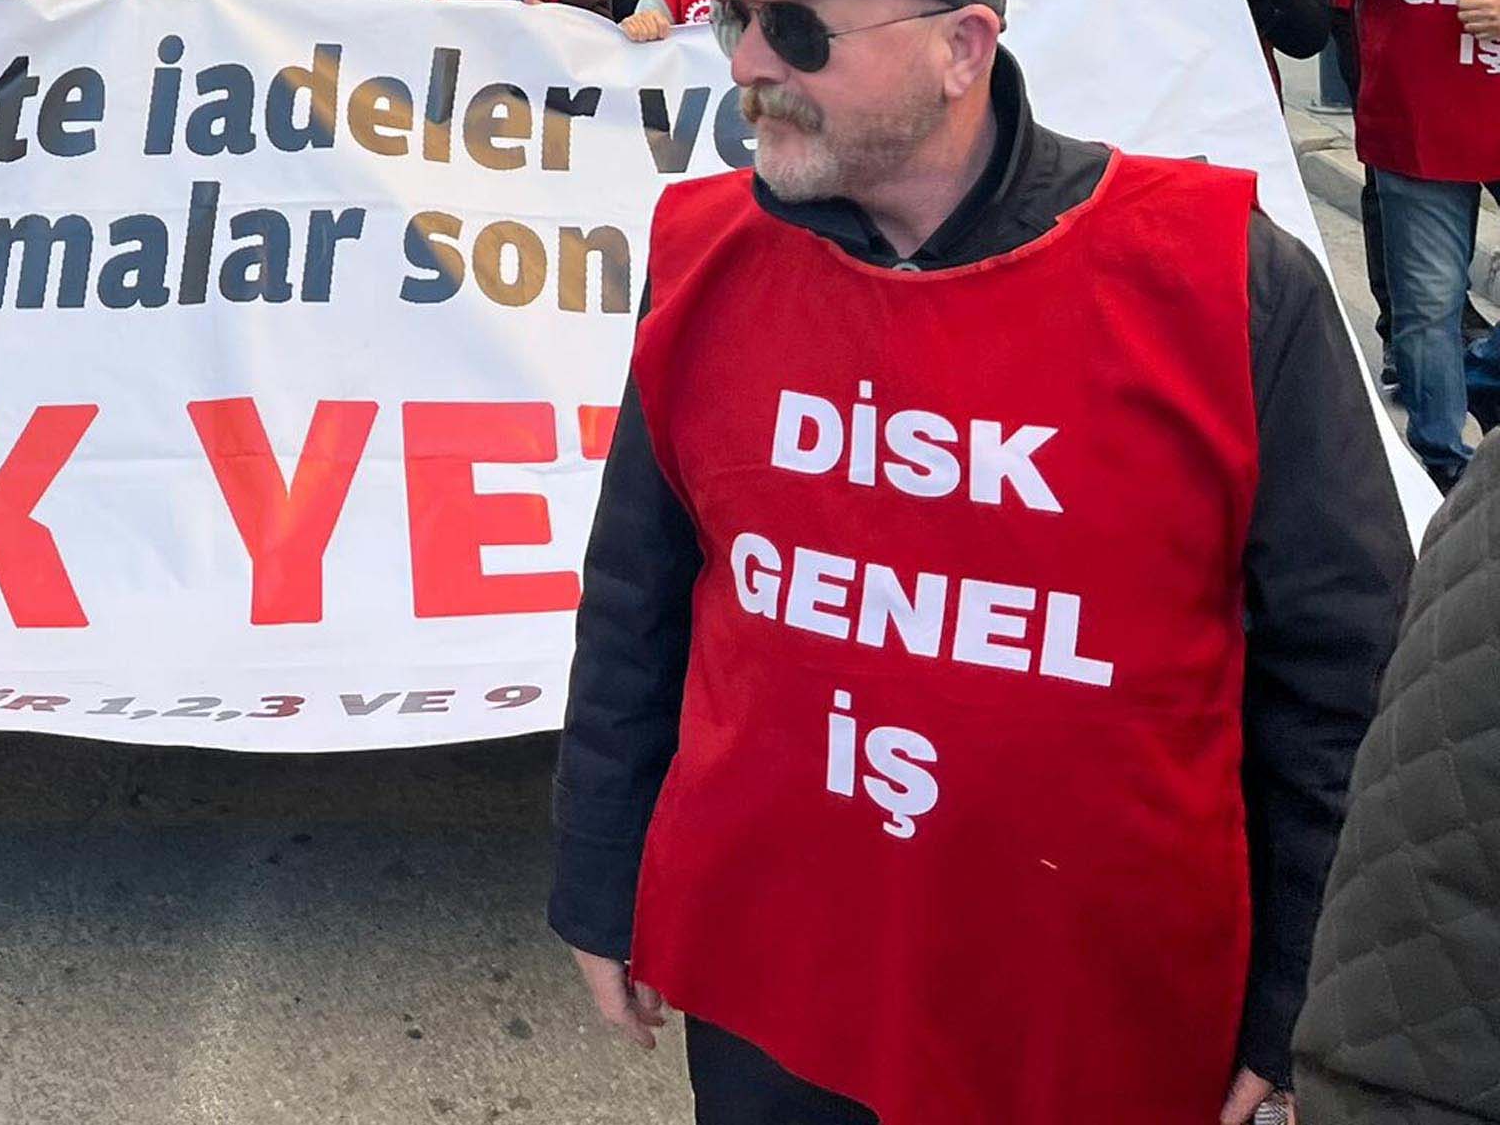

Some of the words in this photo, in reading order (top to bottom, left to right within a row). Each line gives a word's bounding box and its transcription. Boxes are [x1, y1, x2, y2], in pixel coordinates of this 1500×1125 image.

[148, 35, 602, 179] iadeler
[770, 379, 1065, 514] DİSK
[729, 531, 1115, 688] GENEL
[338, 685, 445, 719] VE
[488, 681, 541, 713] 9
[825, 689, 940, 839] İŞ
